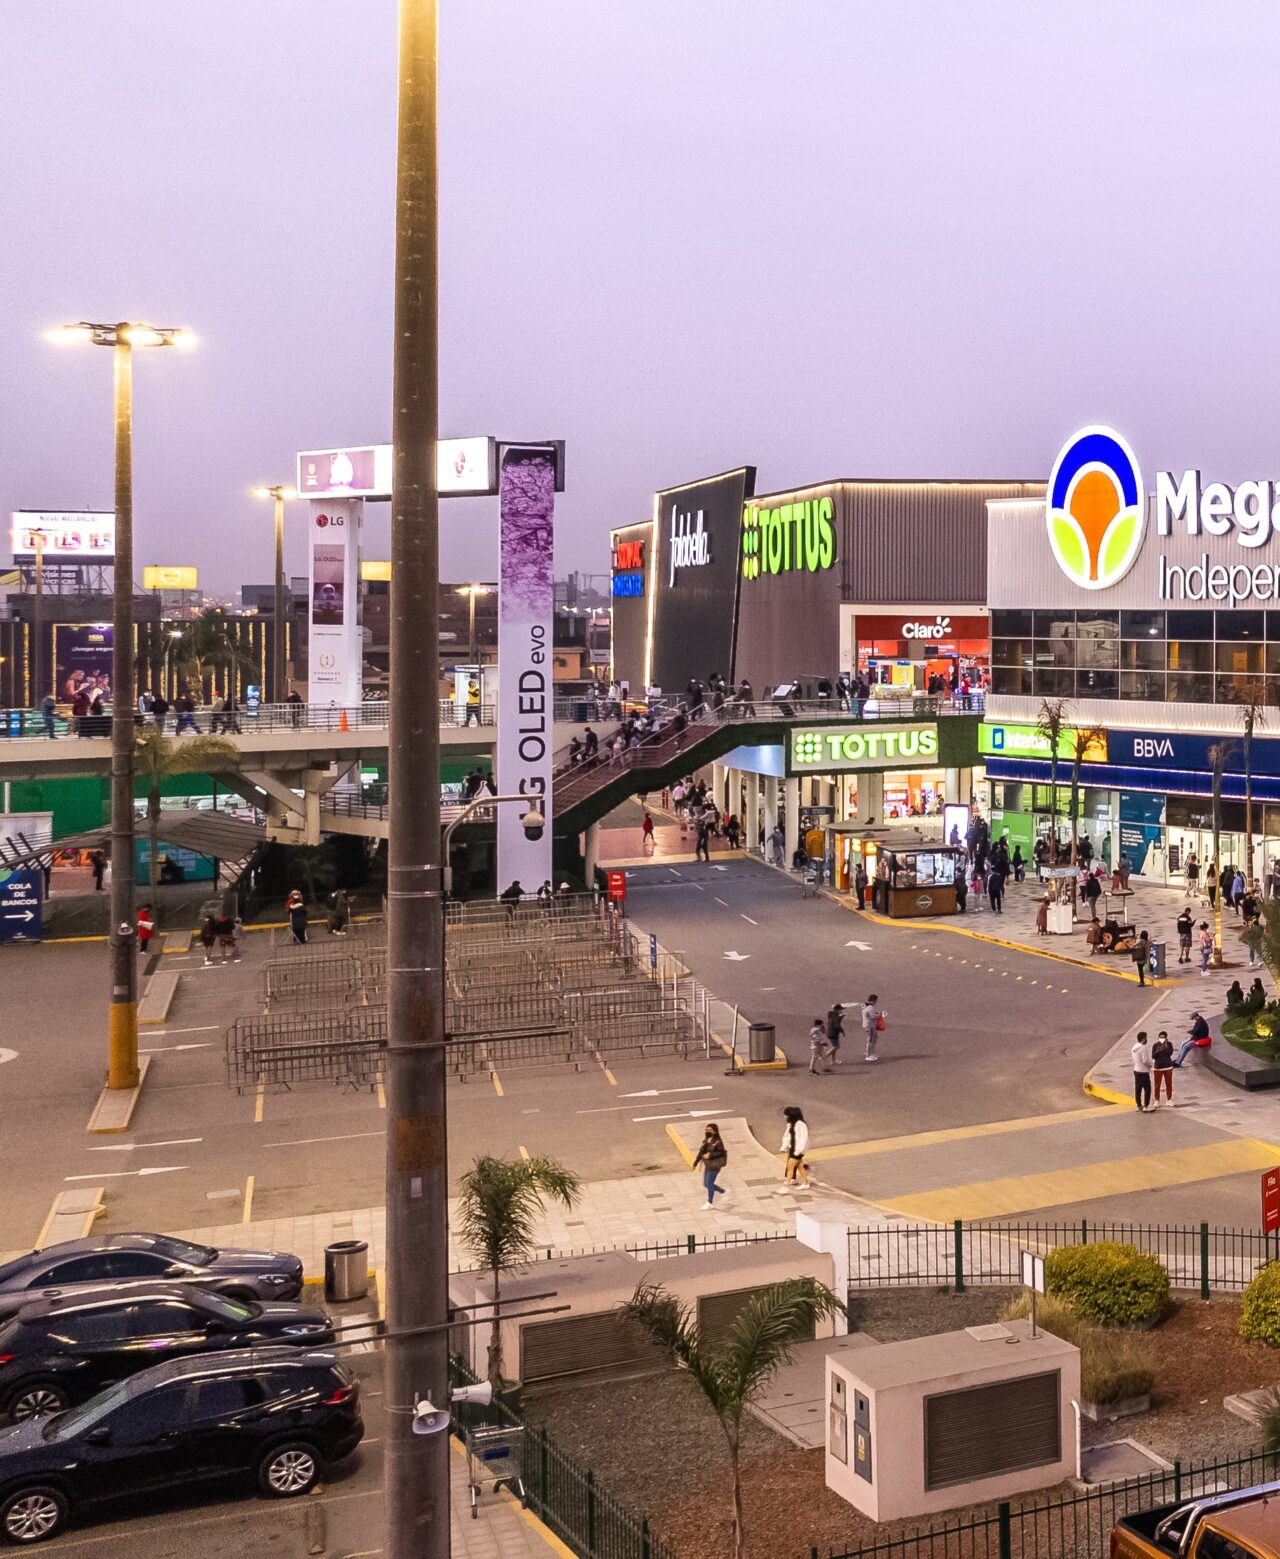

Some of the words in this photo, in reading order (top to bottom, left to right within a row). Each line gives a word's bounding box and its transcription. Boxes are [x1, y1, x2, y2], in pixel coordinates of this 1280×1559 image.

[330, 516, 344, 526] LG
[758, 496, 834, 575] TOTTUS
[902, 622, 944, 638] Claro
[531, 624, 546, 665] evo
[518, 670, 546, 762] OLED
[826, 730, 938, 760] TOTTUS
[1006, 732, 1056, 751] Interban
[1134, 738, 1175, 758] BBVA
[1, 898, 38, 906] BANCOS
